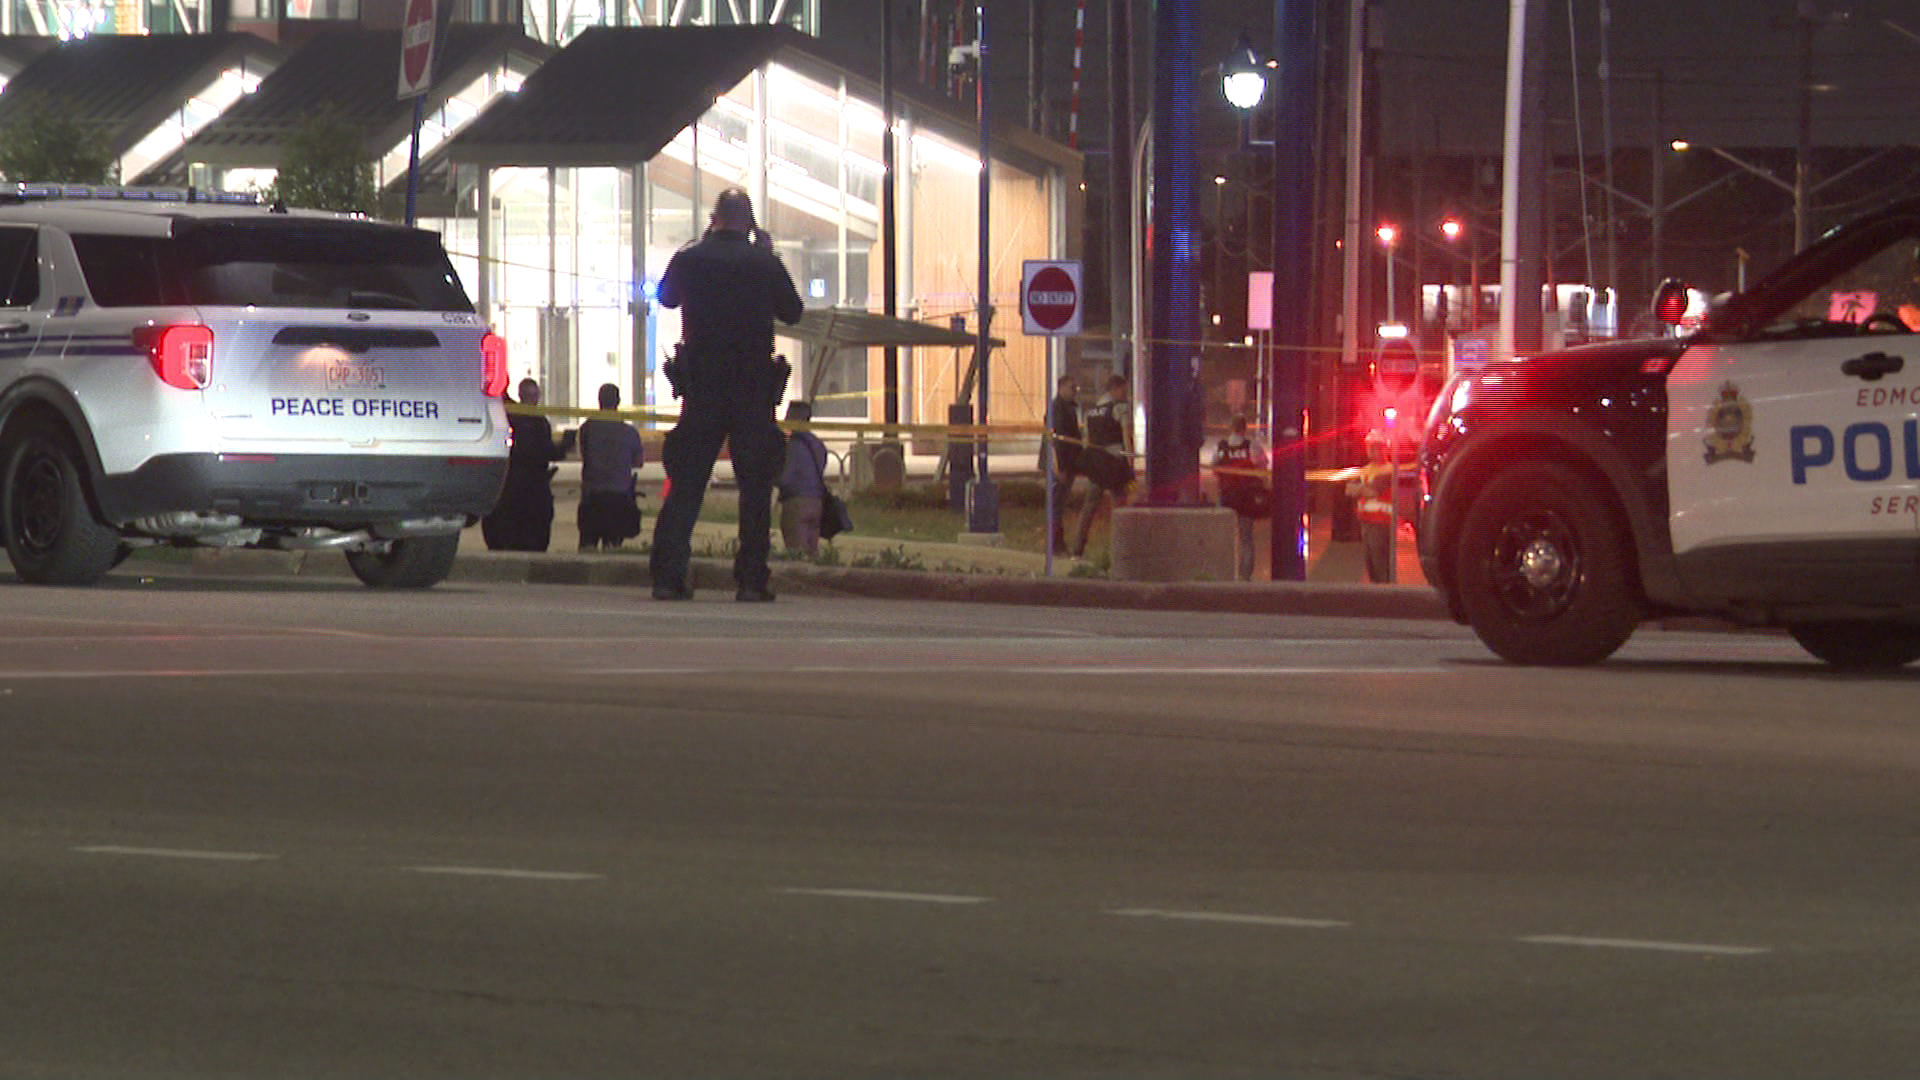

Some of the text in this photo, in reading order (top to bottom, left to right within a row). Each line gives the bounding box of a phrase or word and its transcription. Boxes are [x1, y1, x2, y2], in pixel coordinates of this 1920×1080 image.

[271, 398, 344, 416] PEACE
[352, 398, 439, 419] OFFICER
[1870, 495, 1920, 515] SER
